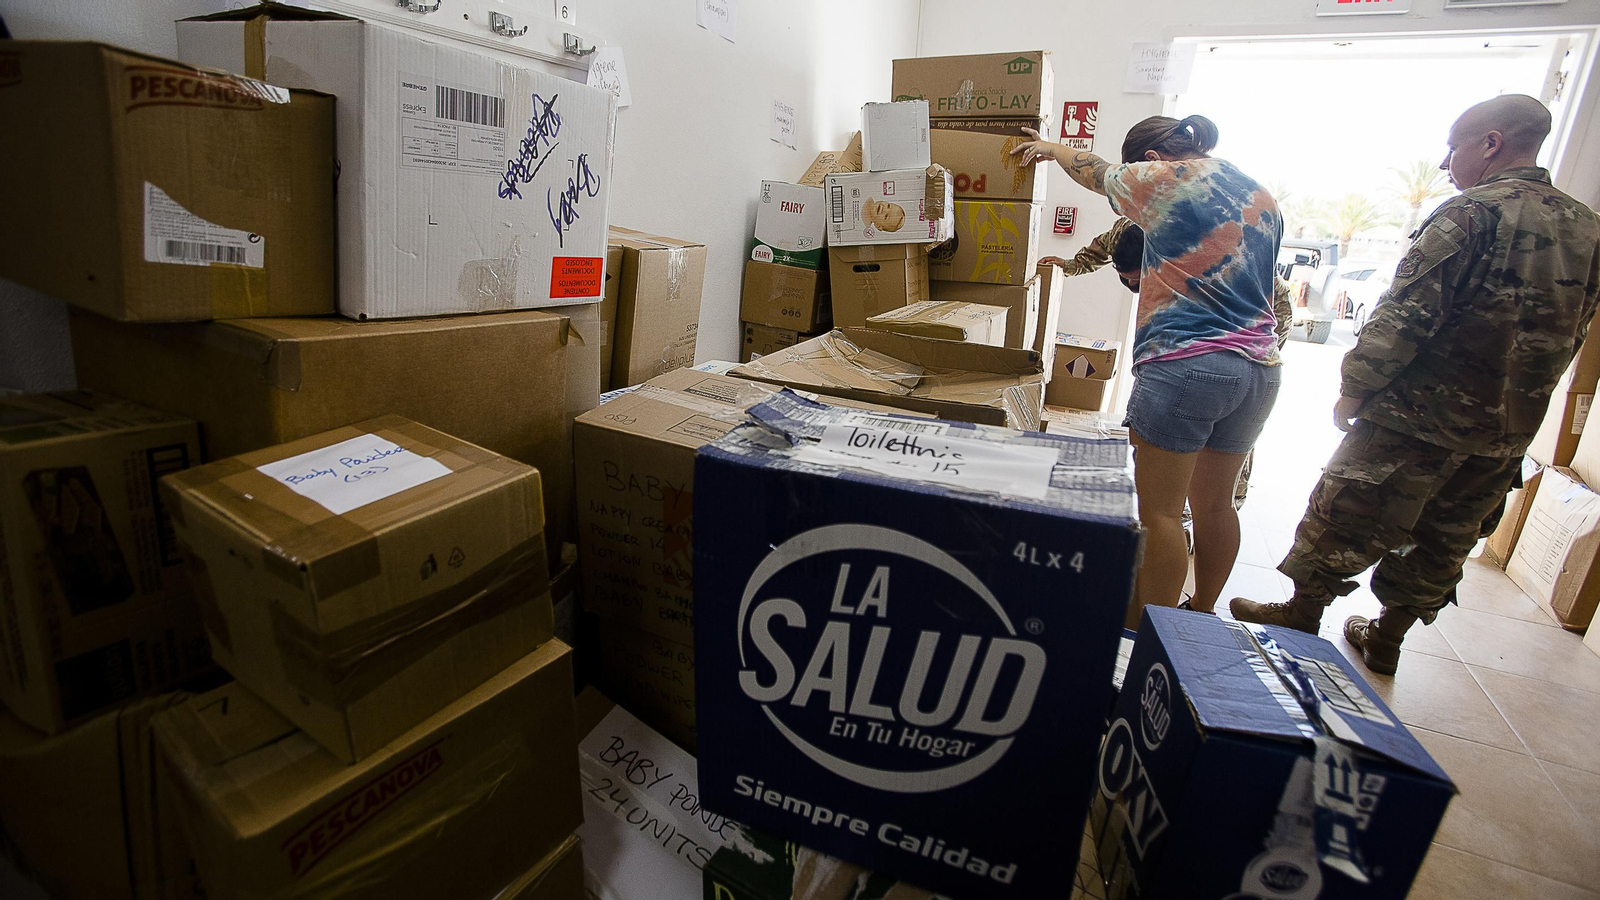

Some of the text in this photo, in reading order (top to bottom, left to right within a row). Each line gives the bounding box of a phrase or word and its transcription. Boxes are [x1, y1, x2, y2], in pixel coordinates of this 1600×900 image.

[562, 5, 569, 19] 6
[1010, 63, 1030, 72] UP
[402, 103, 426, 114] Express
[988, 120, 1005, 128] buen
[780, 201, 805, 214] FAIRY
[1058, 207, 1074, 215] FIRE
[755, 250, 772, 260] FAIRY
[563, 287, 590, 295] CONTIENE
[285, 467, 338, 485] Baby
[603, 460, 685, 510] BABY
[589, 499, 690, 541] NAPPY CREAM
[589, 522, 641, 547] POWDER
[588, 543, 641, 566] LOTION
[1045, 553, 1062, 570] x
[1069, 551, 1085, 574] 4
[830, 562, 891, 618] LA
[652, 640, 695, 671] BABY
[737, 597, 1047, 737] SALUD
[1140, 676, 1171, 742] SALUD
[829, 715, 976, 759] En Tu Hogar
[599, 735, 674, 789] BABY
[288, 747, 443, 875] PESCANOVA
[587, 778, 713, 871] 24 UNITS
[734, 774, 1019, 884] Siempre Calidad
